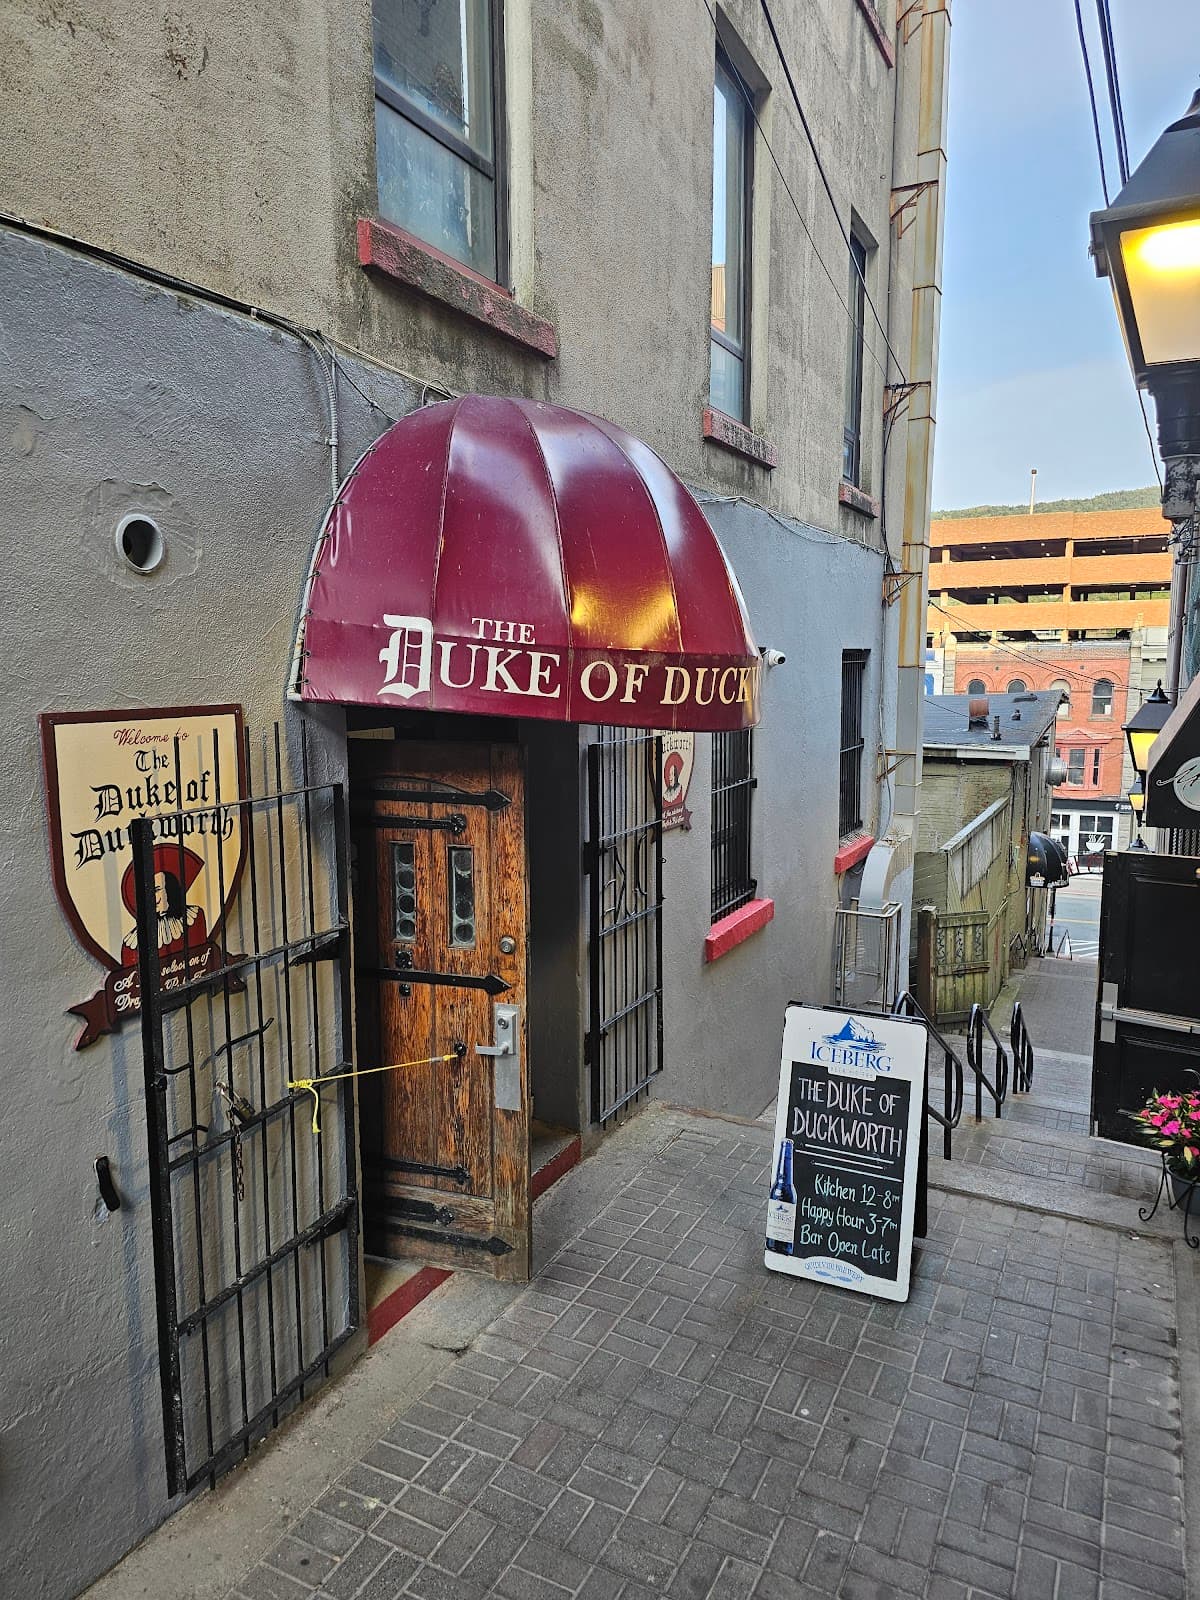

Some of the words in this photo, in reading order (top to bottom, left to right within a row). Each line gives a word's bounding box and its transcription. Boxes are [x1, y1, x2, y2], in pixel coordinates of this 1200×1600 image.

[471, 616, 537, 645] THE
[377, 613, 561, 699] DUKE
[580, 660, 649, 704] OF
[113, 728, 169, 746] Welcome
[175, 727, 190, 741] to
[134, 749, 169, 772] The
[89, 775, 177, 823] Duke
[186, 770, 210, 802] of
[810, 1040, 893, 1072] ICEBERG
[798, 1077, 826, 1103] THE
[827, 1080, 875, 1116] DUKE
[879, 1093, 901, 1116] OF
[791, 1107, 903, 1158] DUCKWORTH
[814, 1173, 856, 1202] Kitchen
[801, 1197, 834, 1227] Happy
[836, 1206, 865, 1230] Hour
[800, 1224, 823, 1245] Bar
[828, 1231, 858, 1257] Open
[861, 1240, 891, 1264] Late
